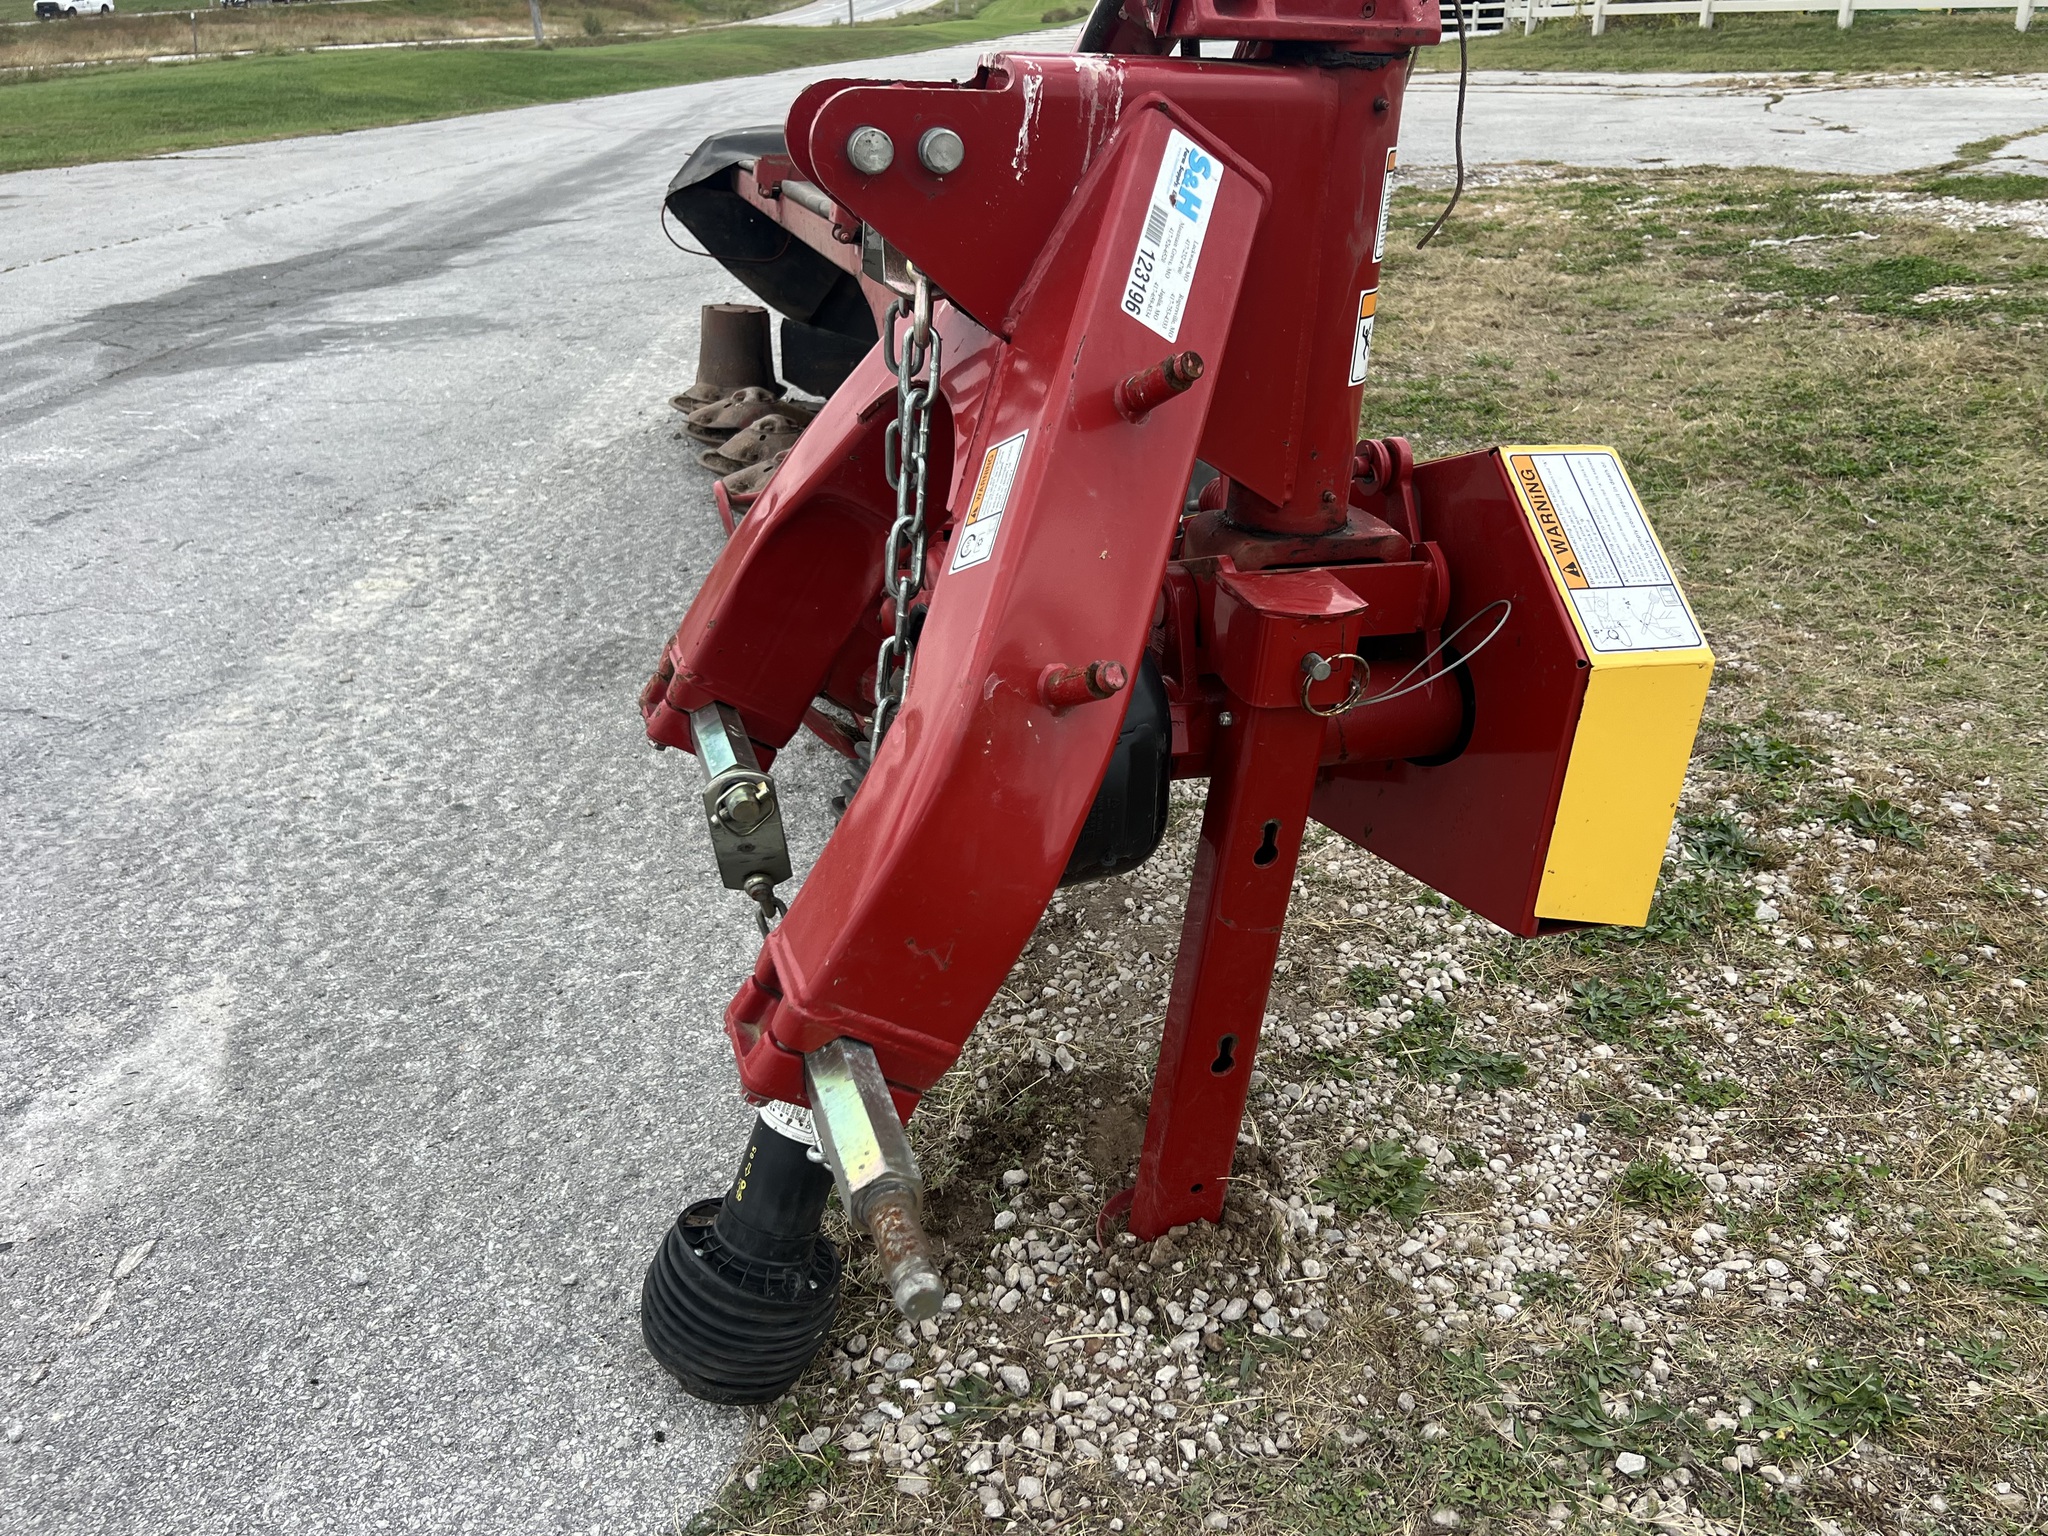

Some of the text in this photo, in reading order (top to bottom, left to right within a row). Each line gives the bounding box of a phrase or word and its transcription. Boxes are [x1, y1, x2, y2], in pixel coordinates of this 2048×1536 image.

[1181, 147, 1190, 165] Farm
[1175, 149, 1211, 221] S&H
[1164, 268, 1172, 280] MO
[1183, 271, 1191, 283] MO
[1125, 249, 1155, 315] 123196
[1153, 309, 1161, 321] MO
[1168, 327, 1176, 339] MO
[975, 454, 994, 503] WARNING
